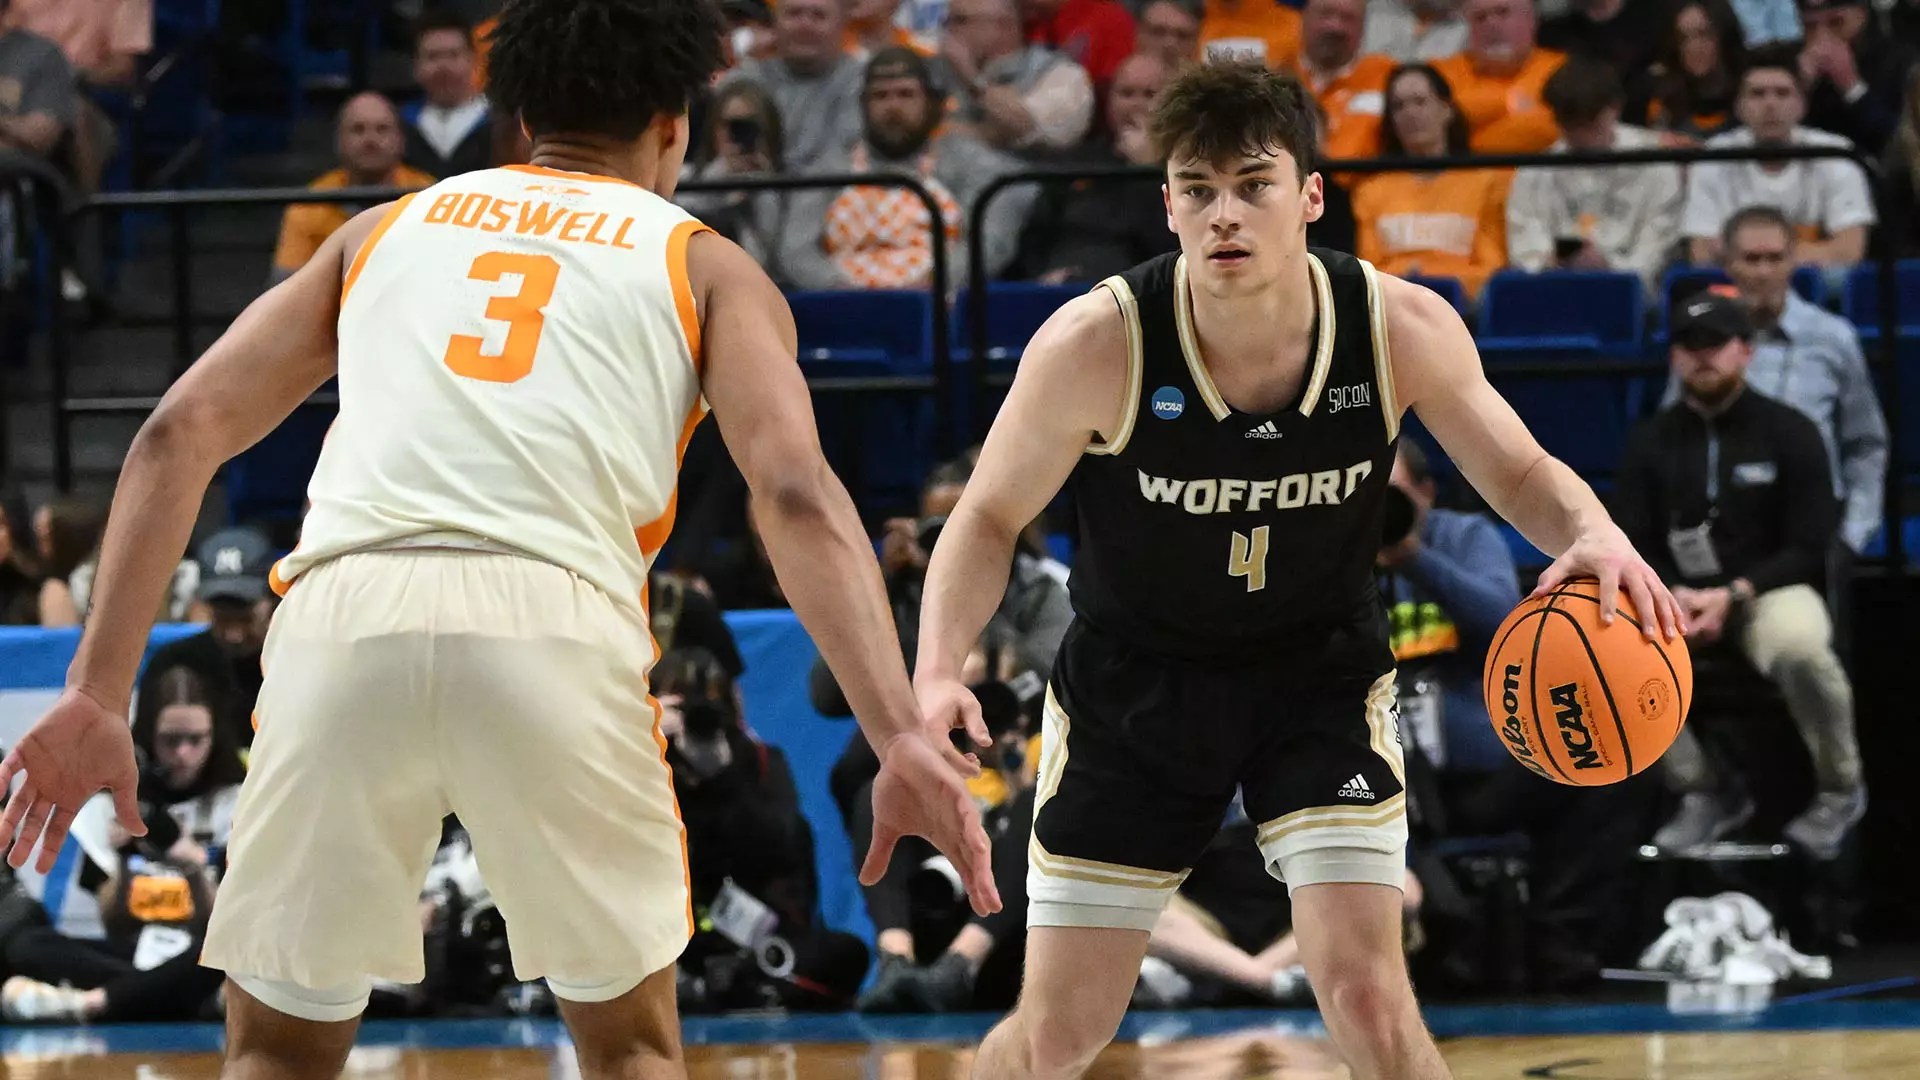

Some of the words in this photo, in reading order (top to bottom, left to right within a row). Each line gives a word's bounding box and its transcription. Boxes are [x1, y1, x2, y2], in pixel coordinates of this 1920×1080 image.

[423, 192, 635, 249] BOSWELL
[443, 251, 561, 383] 3
[1155, 401, 1183, 413] NCAA
[1244, 431, 1283, 440] adidas
[1137, 460, 1372, 515] WOFFORD
[1228, 525, 1270, 592] 4
[1549, 682, 1604, 770] NCAA
[1337, 788, 1375, 799] adidas
